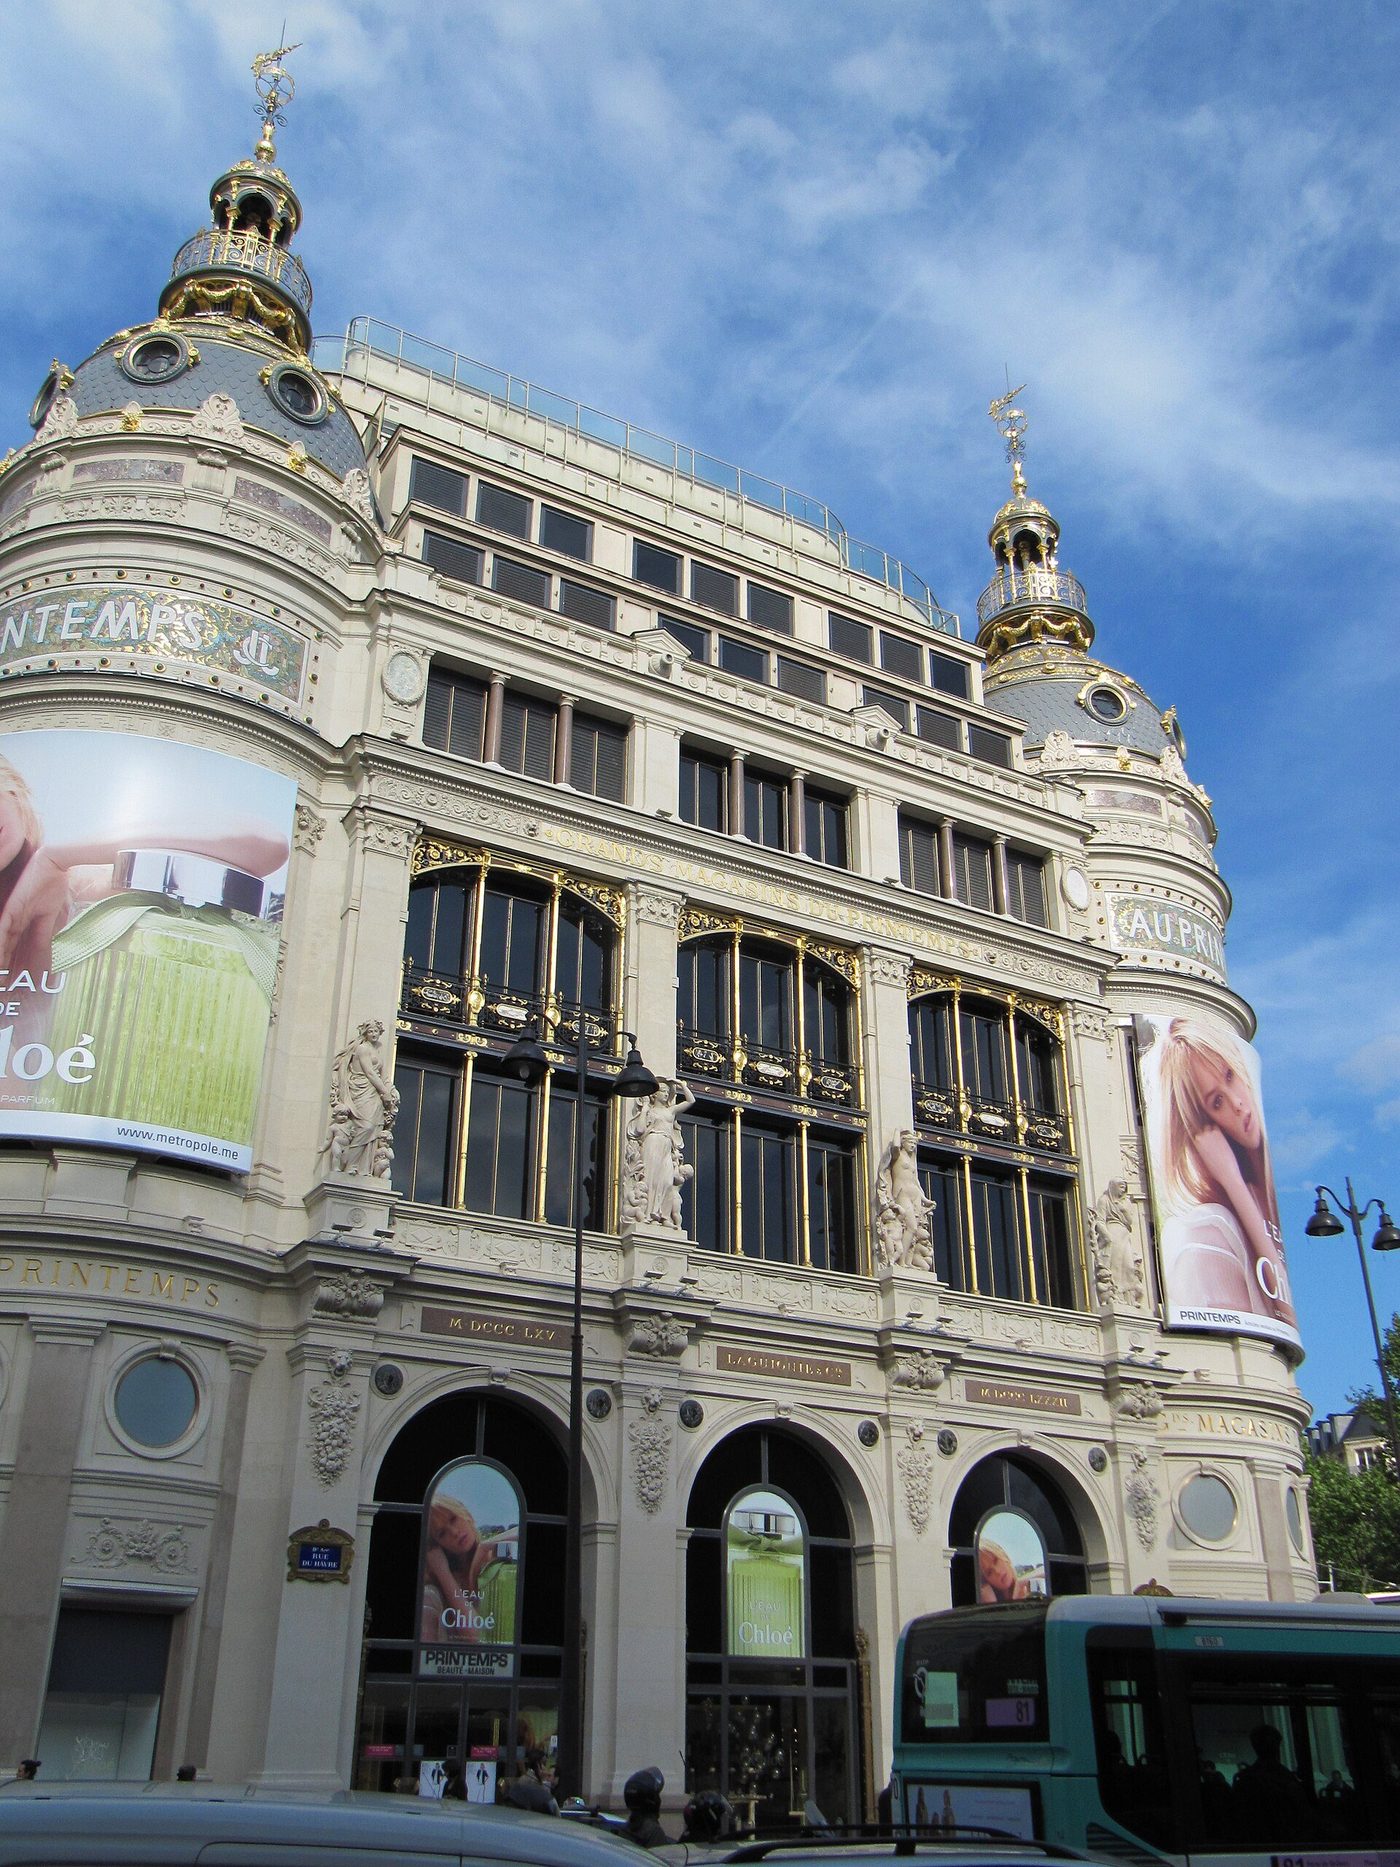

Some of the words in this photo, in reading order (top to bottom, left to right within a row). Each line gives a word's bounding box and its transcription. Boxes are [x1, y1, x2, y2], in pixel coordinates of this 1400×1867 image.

[556, 828, 664, 873] GRANDS
[674, 860, 800, 911] MAGASINS
[847, 909, 969, 958] PRINTEMPS
[1129, 908, 1171, 942] AU
[117, 1127, 239, 1160] www.metropole.me
[1179, 1310, 1241, 1325] PRINTEMPS
[449, 1318, 462, 1330] M
[470, 1320, 515, 1336] DCCC
[524, 1327, 555, 1340] LXV
[314, 1560, 338, 1568] HAVRE
[455, 1588, 485, 1600] L'EAU
[441, 1608, 496, 1630] Chloé
[738, 1621, 794, 1645] Chloé
[425, 1650, 509, 1668] PRINTEMPS
[469, 1667, 495, 1675] MAISON
[1015, 1701, 1029, 1722] 81
